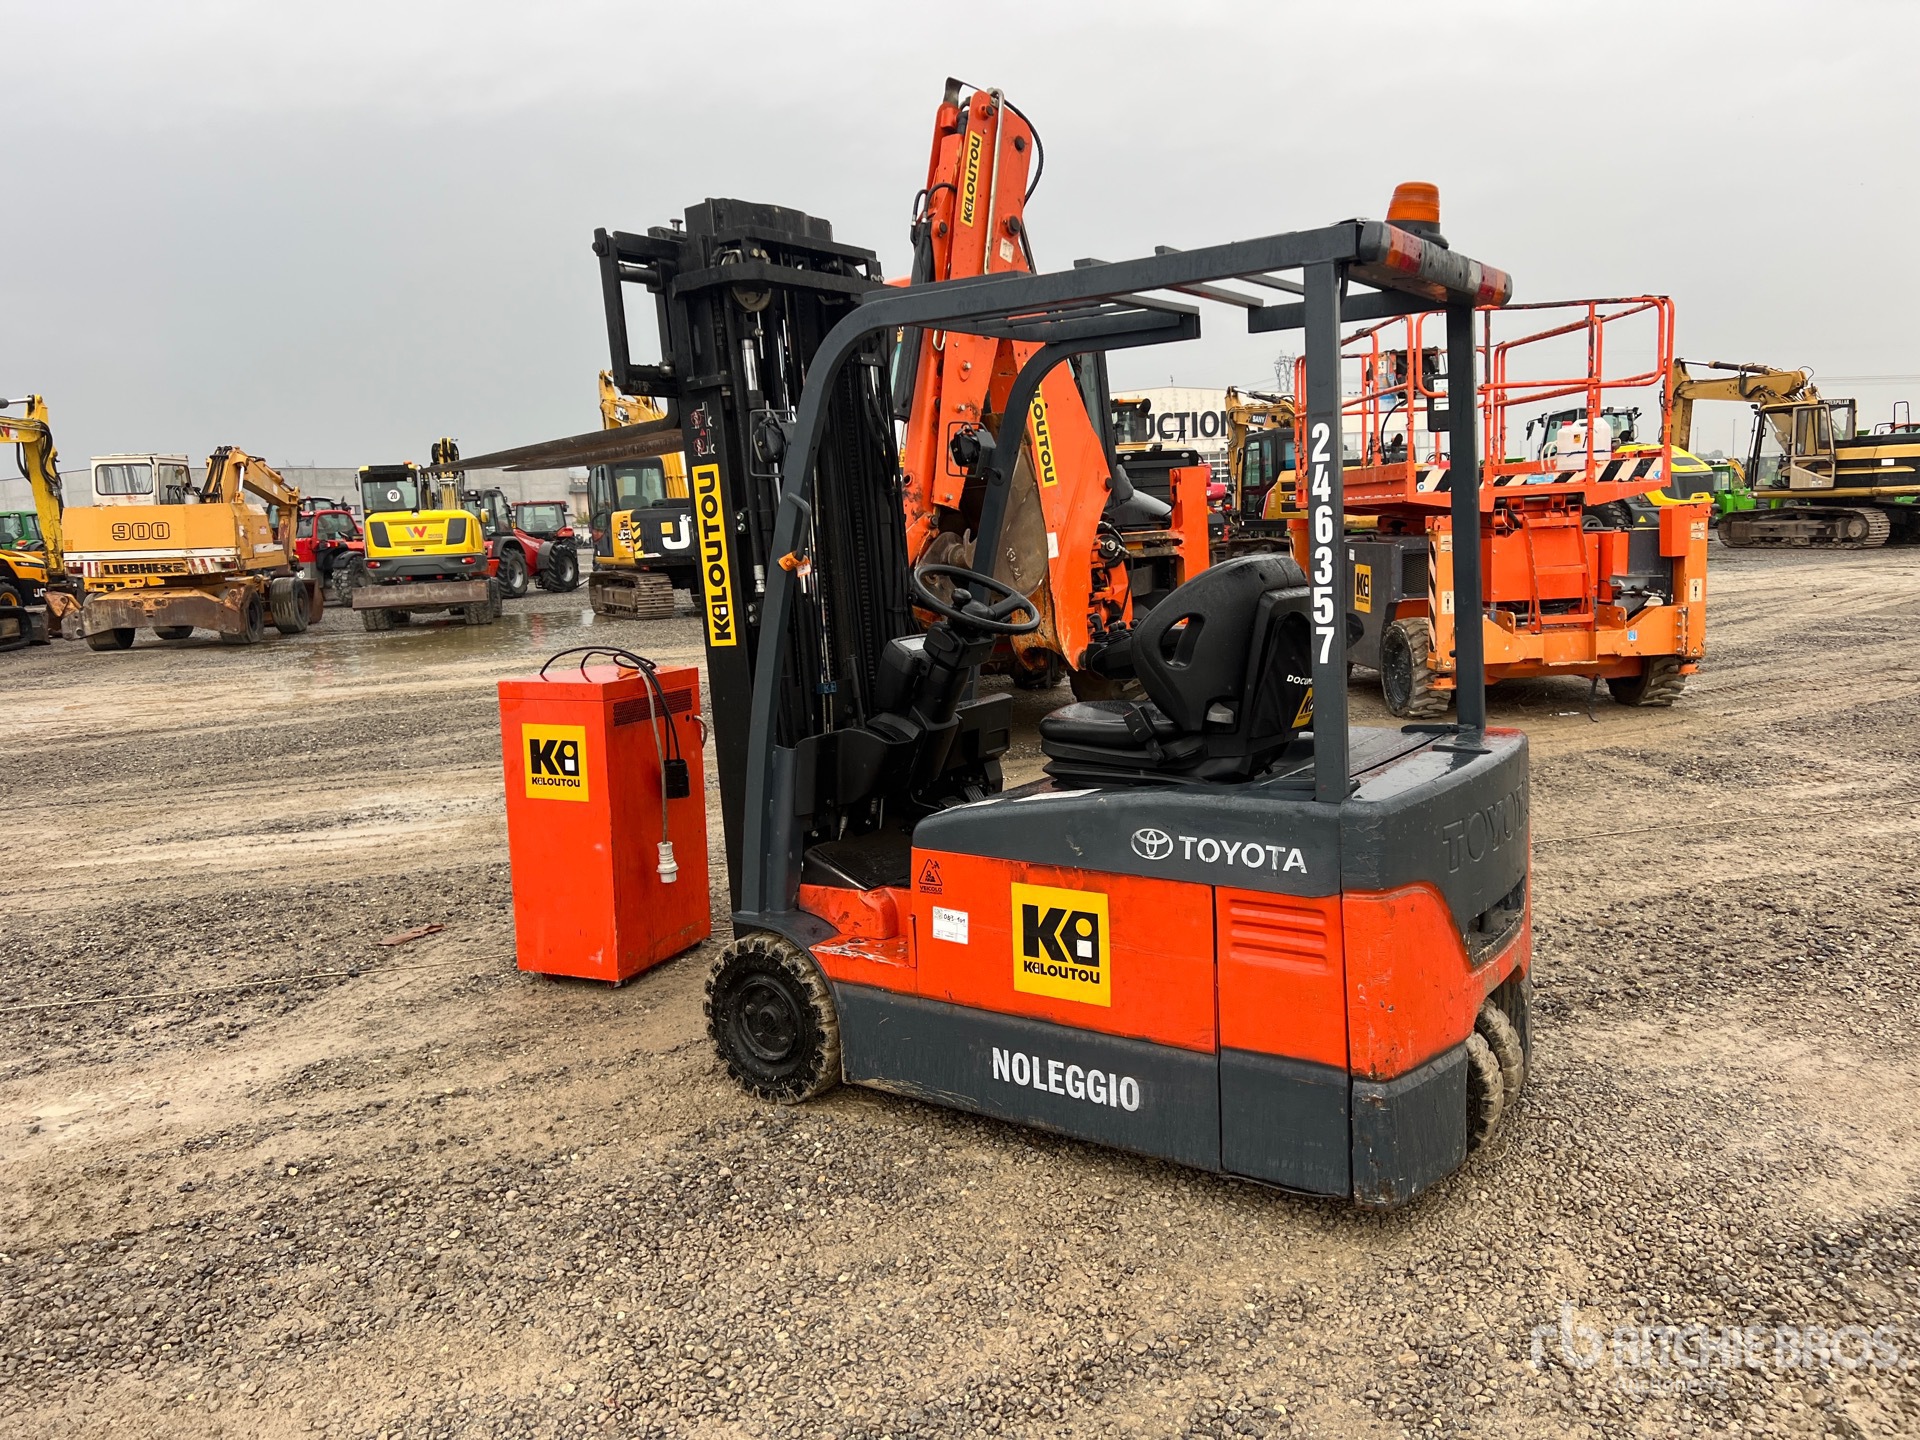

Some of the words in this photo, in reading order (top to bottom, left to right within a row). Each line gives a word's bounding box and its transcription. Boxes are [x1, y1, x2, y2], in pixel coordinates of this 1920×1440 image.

[111, 521, 170, 541] 900
[1311, 422, 1335, 664] 246357
[1178, 835, 1308, 874] TOYOTA
[992, 1047, 1140, 1112] NOLEGGIO
